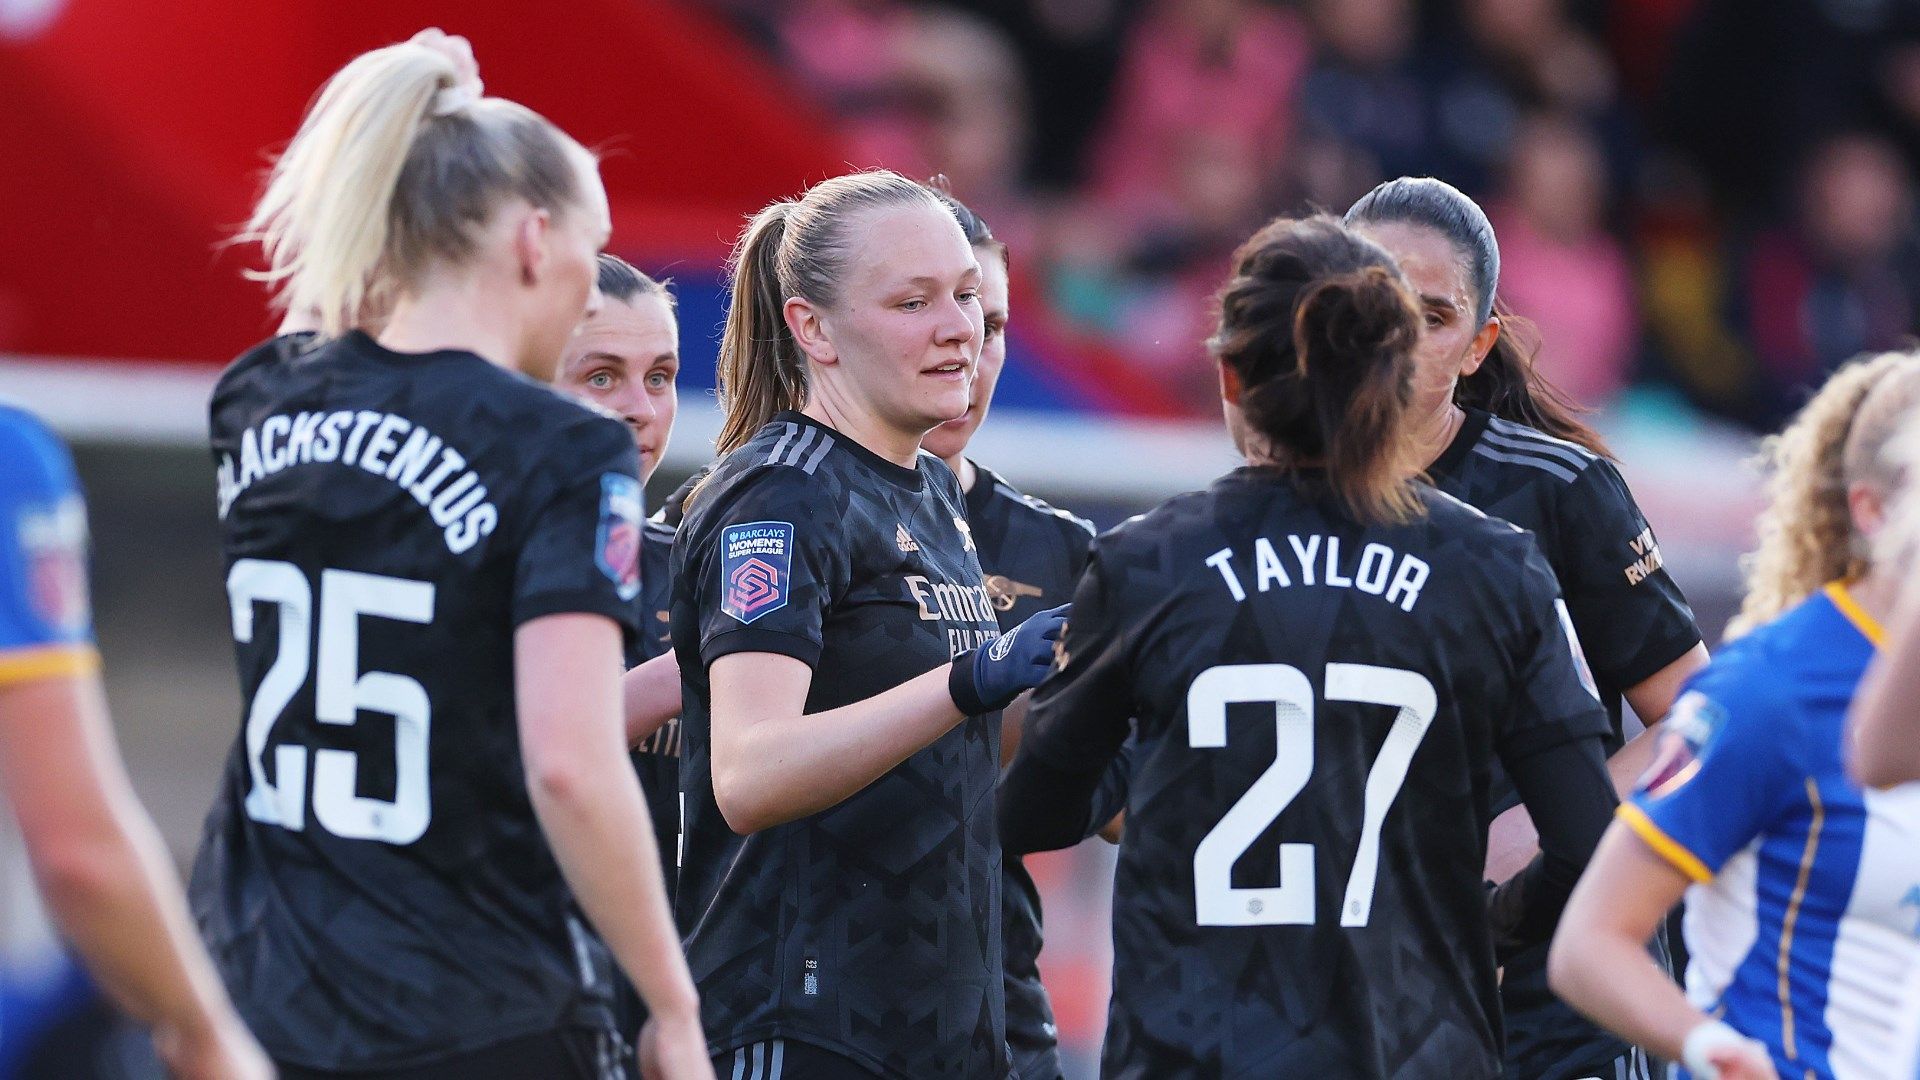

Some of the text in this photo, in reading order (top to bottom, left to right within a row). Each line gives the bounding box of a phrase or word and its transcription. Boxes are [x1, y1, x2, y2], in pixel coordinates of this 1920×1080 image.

[728, 549, 751, 559] SUPER
[729, 539, 784, 552] WOMEN'S
[740, 529, 785, 539] BARCLAYS
[1205, 534, 1431, 612] TAYLOR
[226, 558, 435, 845] 25
[1187, 662, 1438, 927] 27
